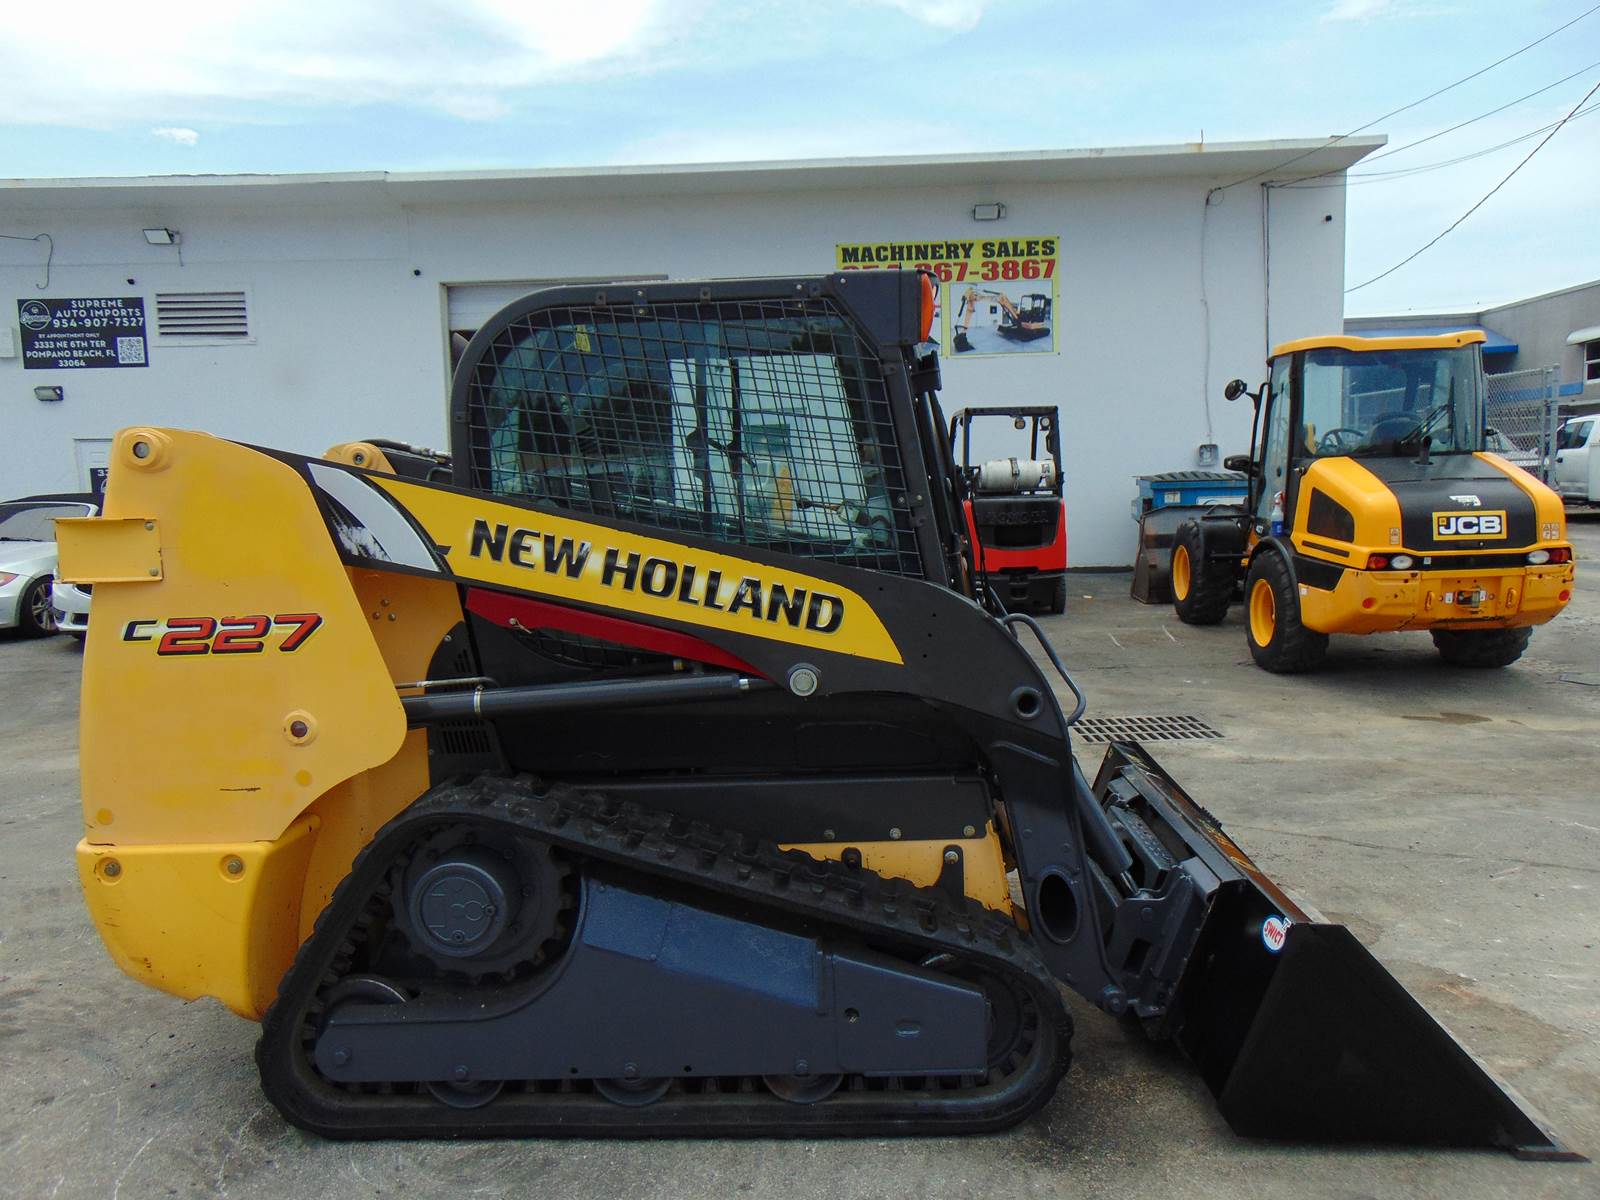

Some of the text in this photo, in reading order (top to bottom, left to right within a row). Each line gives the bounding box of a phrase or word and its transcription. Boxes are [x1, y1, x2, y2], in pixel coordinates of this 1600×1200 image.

[842, 240, 1056, 262] MACHINERY SALES
[71, 299, 124, 308] SUPREME
[56, 308, 87, 318] AUTO
[90, 308, 141, 317] IMPORTS
[53, 318, 144, 328] 954-907-7527
[34, 341, 55, 349] 3333
[26, 350, 70, 358] POMPANO
[73, 350, 105, 358] BEACH,
[58, 359, 86, 367] 33064
[1439, 516, 1501, 534] JCB
[469, 519, 844, 635] NEW HOLLAND
